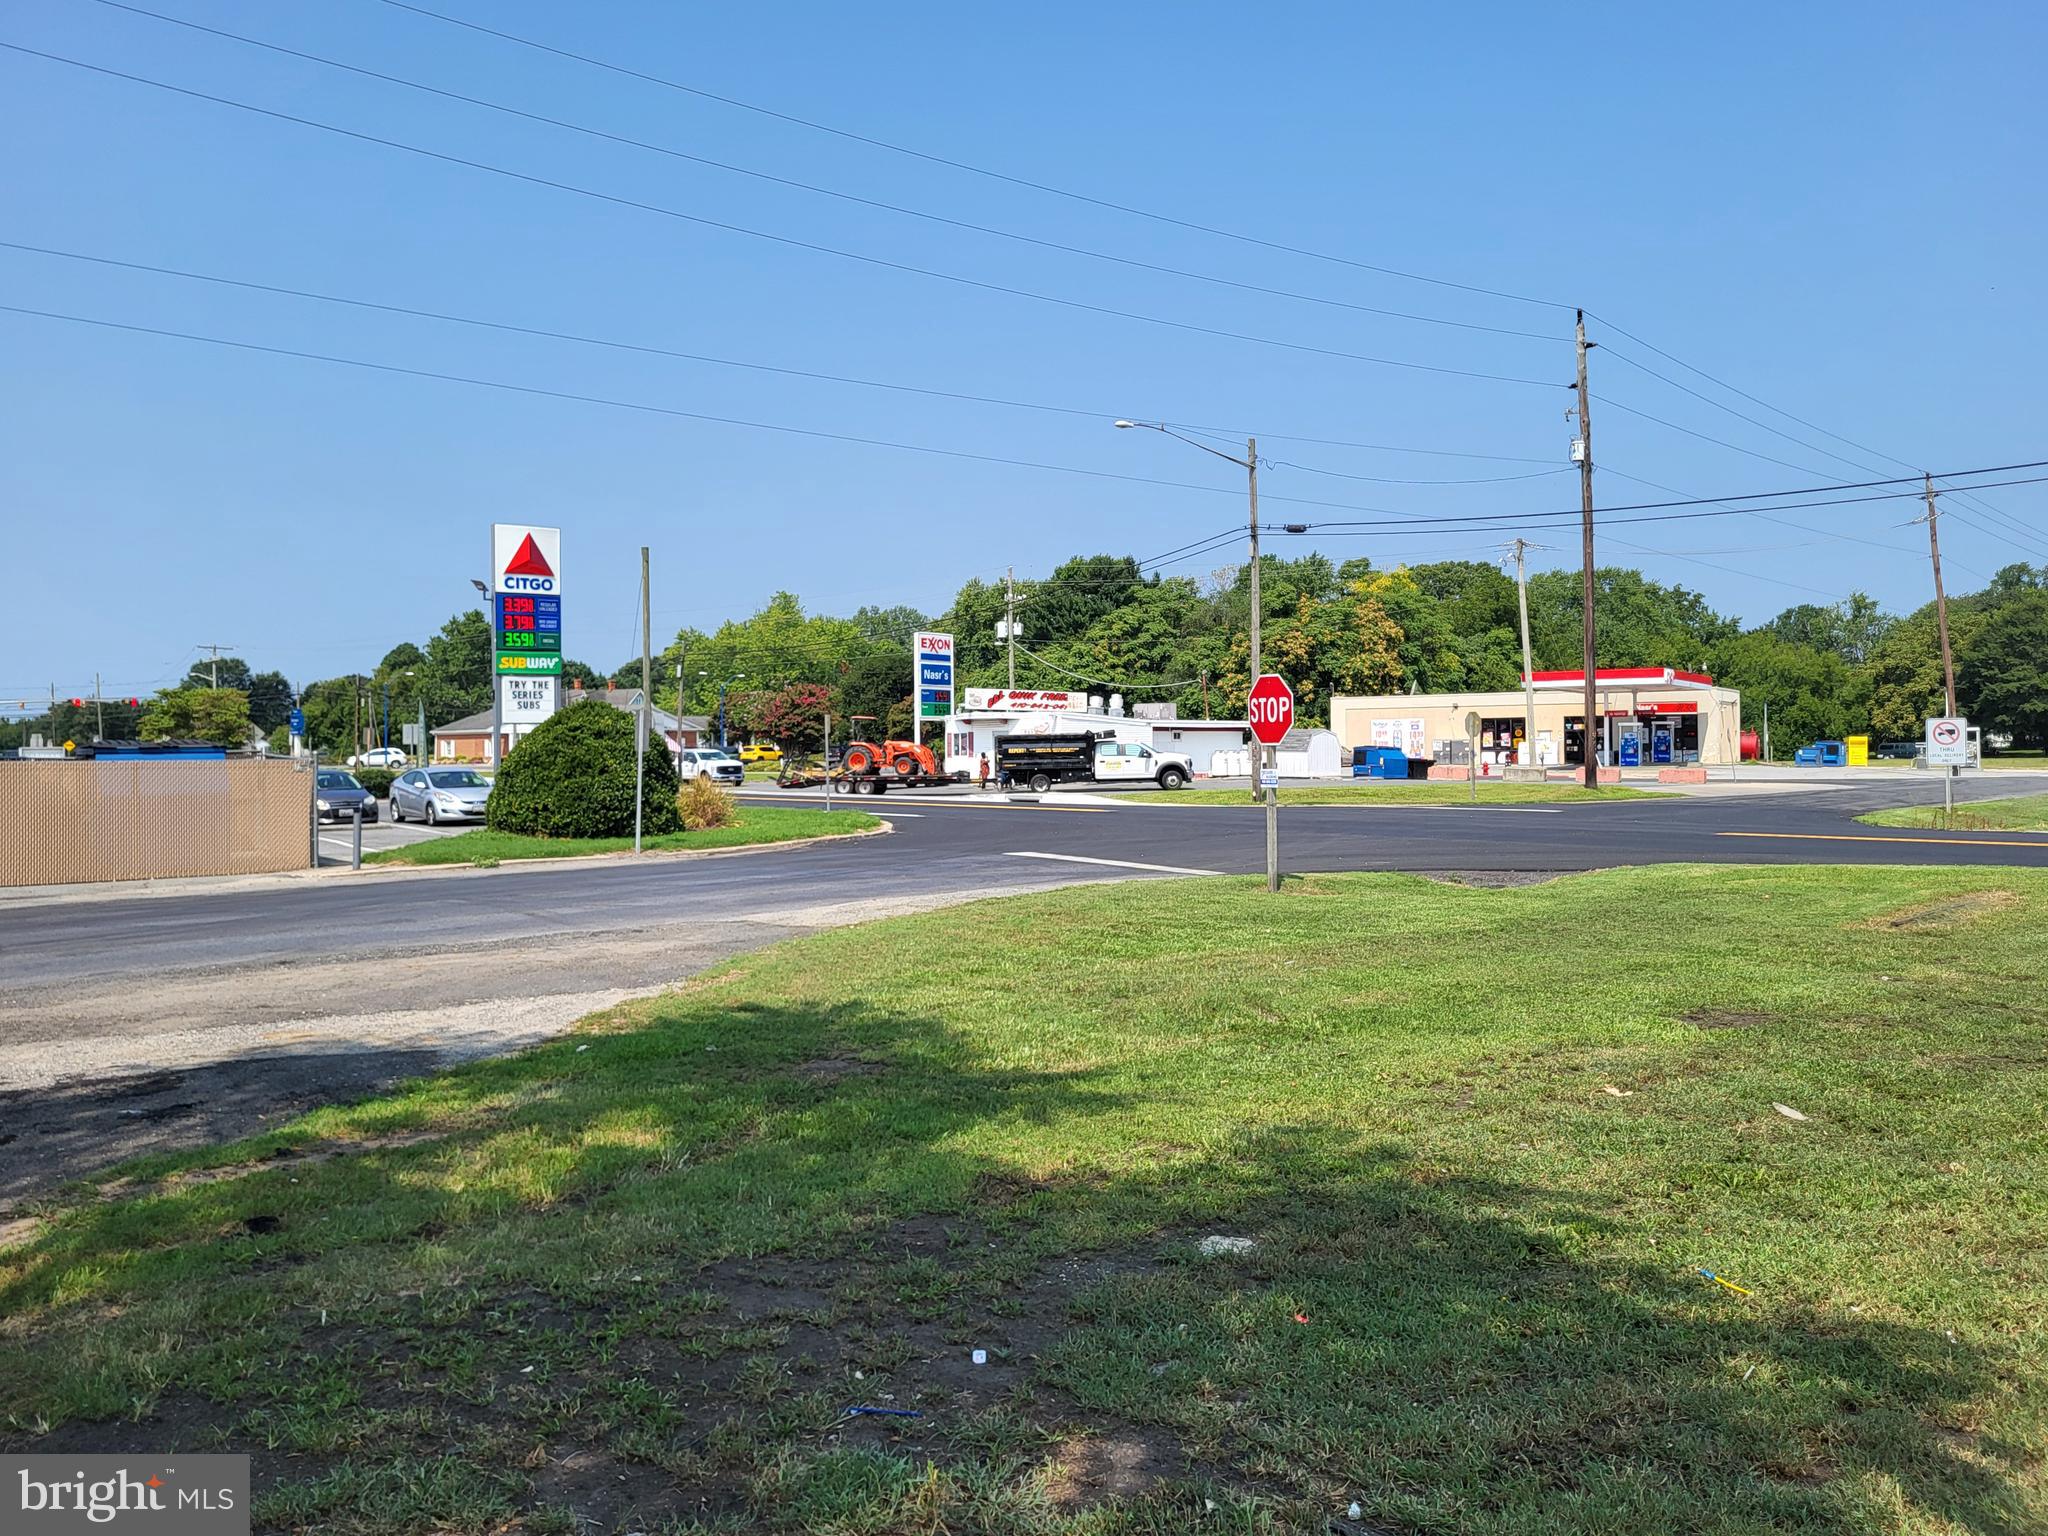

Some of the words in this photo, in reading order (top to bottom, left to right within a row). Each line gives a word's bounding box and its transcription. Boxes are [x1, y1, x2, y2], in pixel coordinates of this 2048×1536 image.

[504, 576, 553, 591] CITGO
[921, 637, 951, 653] EXXON
[499, 656, 558, 669] SUBWAY
[923, 669, 949, 680] Nasr's
[509, 681, 527, 689] TRY
[532, 681, 549, 689] THE
[512, 691, 544, 699] SERIES
[517, 701, 541, 709] SUBS
[1250, 697, 1290, 723] STOP
